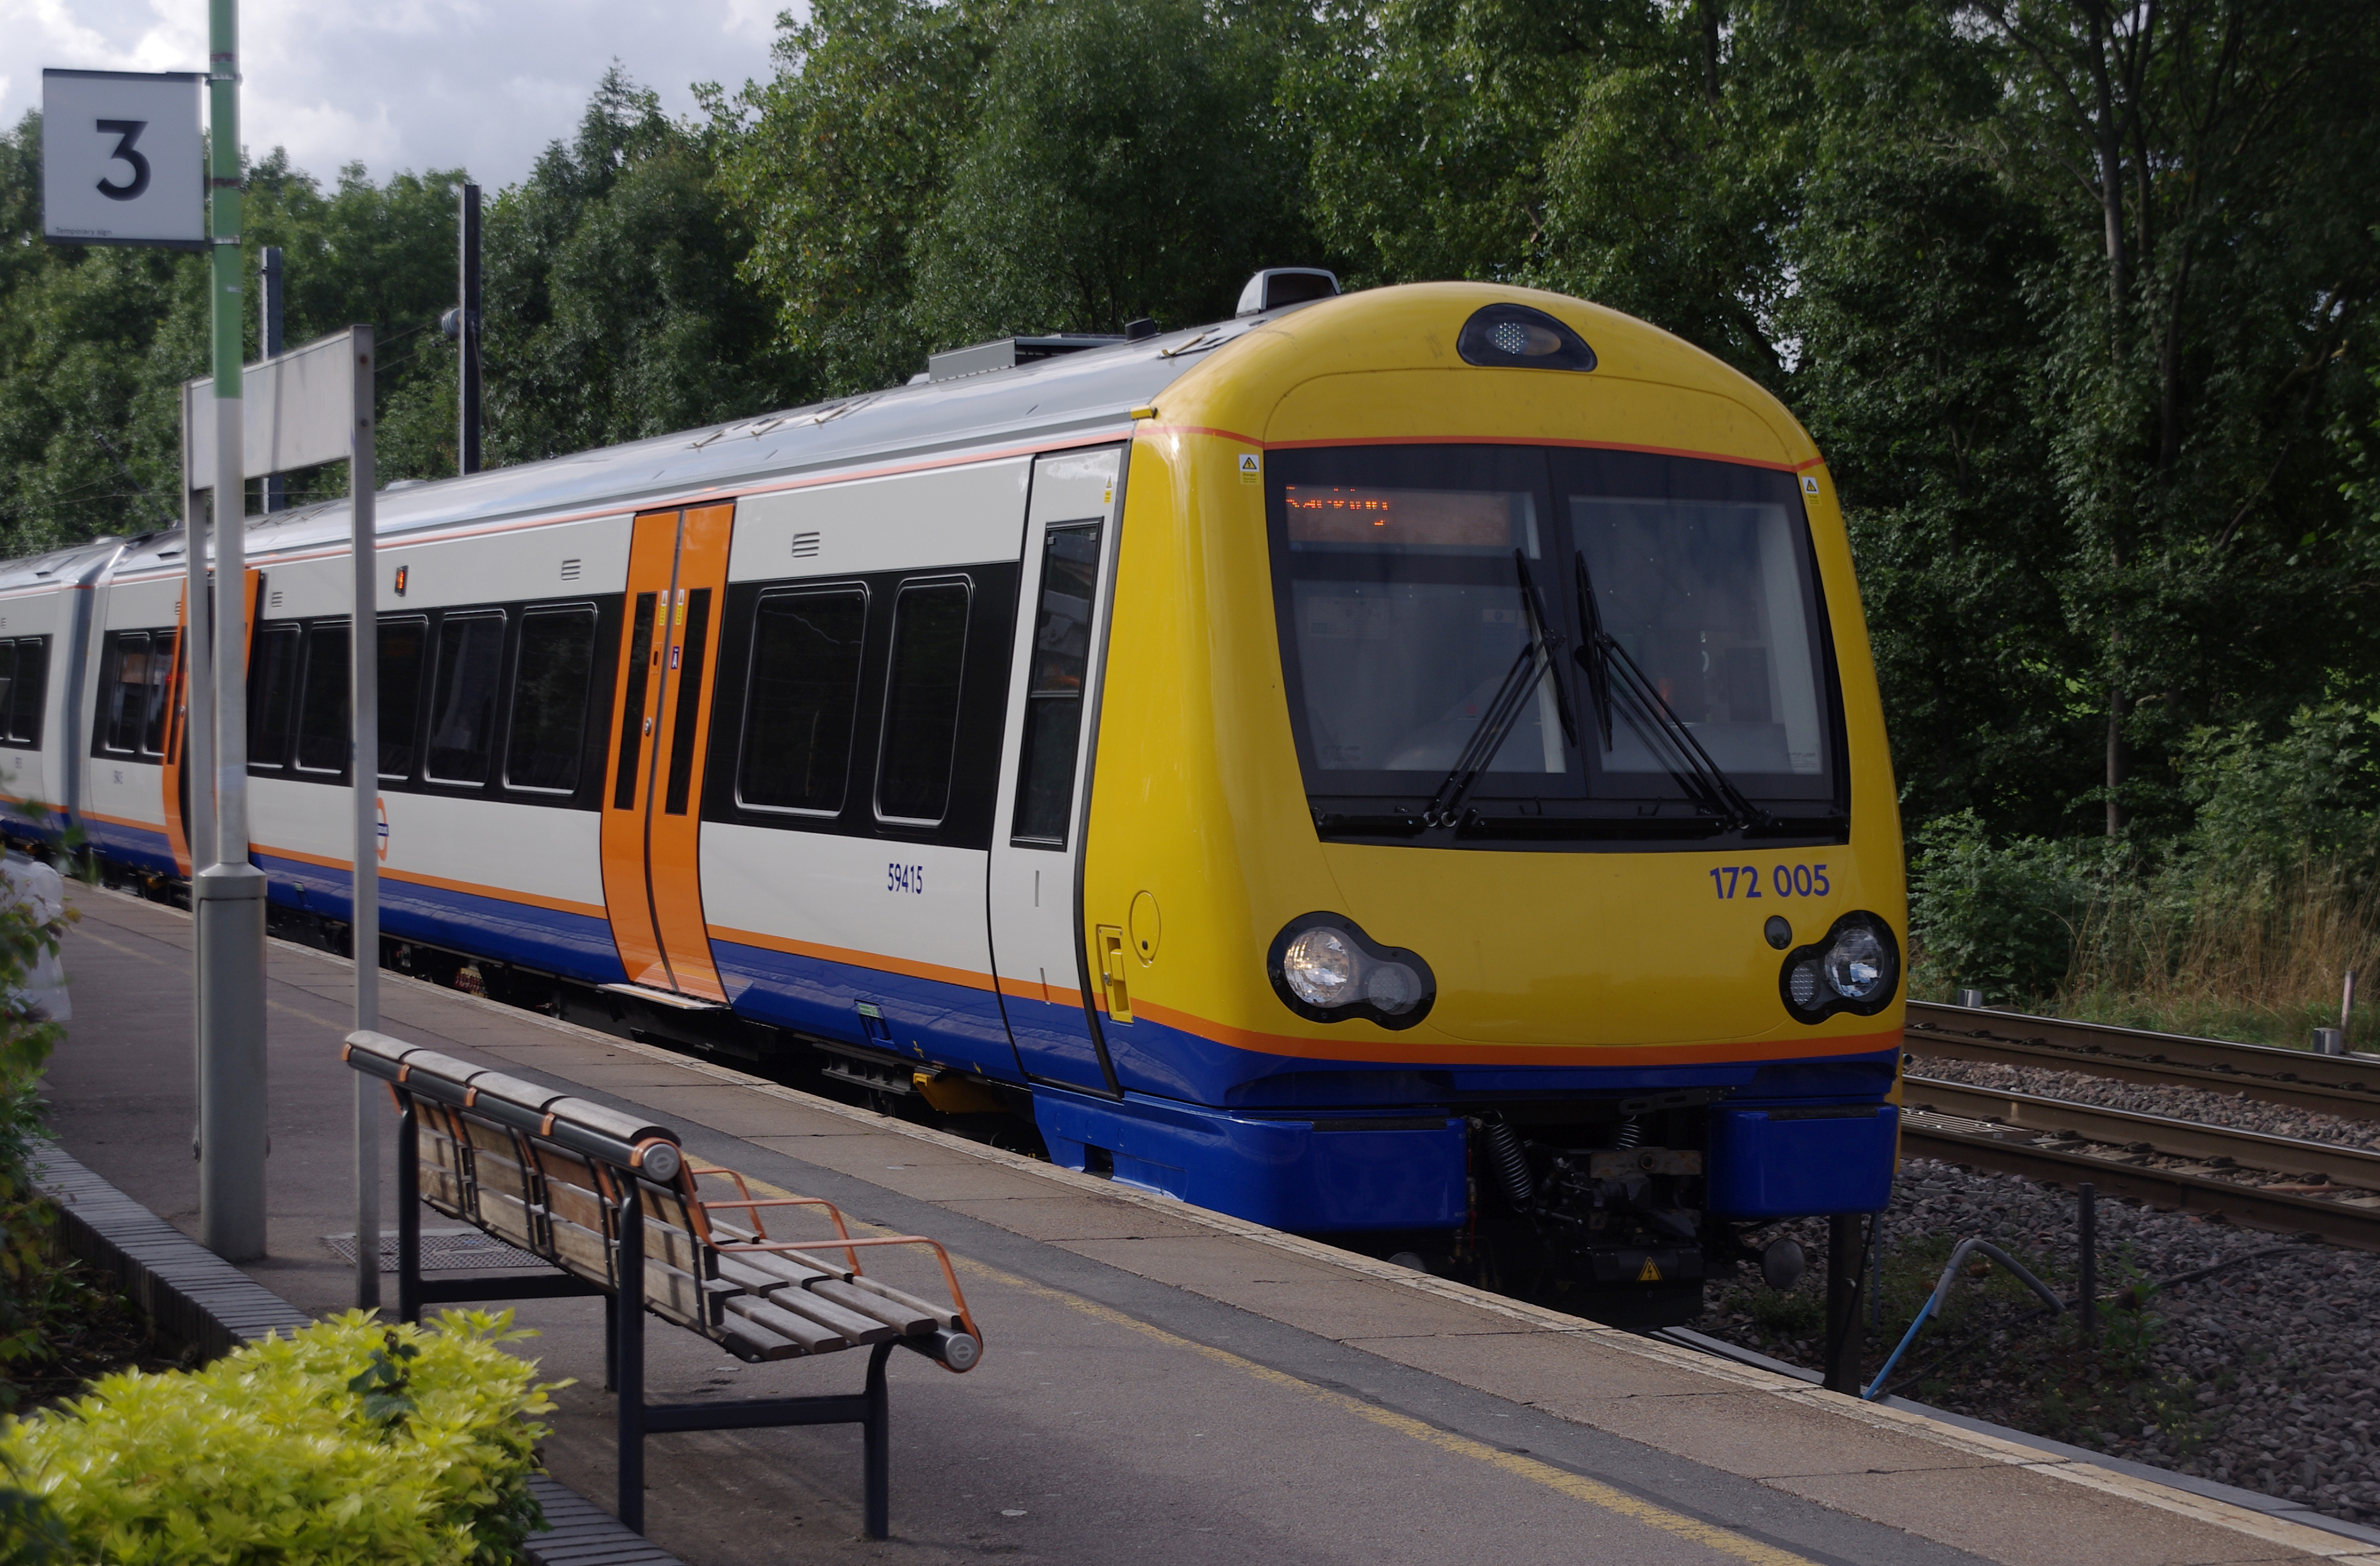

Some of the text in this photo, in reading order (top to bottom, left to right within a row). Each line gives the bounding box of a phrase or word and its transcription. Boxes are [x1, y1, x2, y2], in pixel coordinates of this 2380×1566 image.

[96, 119, 151, 202] 3
[56, 227, 112, 236] Temporary sign
[887, 863, 923, 895] 59415
[1709, 864, 1830, 899] 172 005
